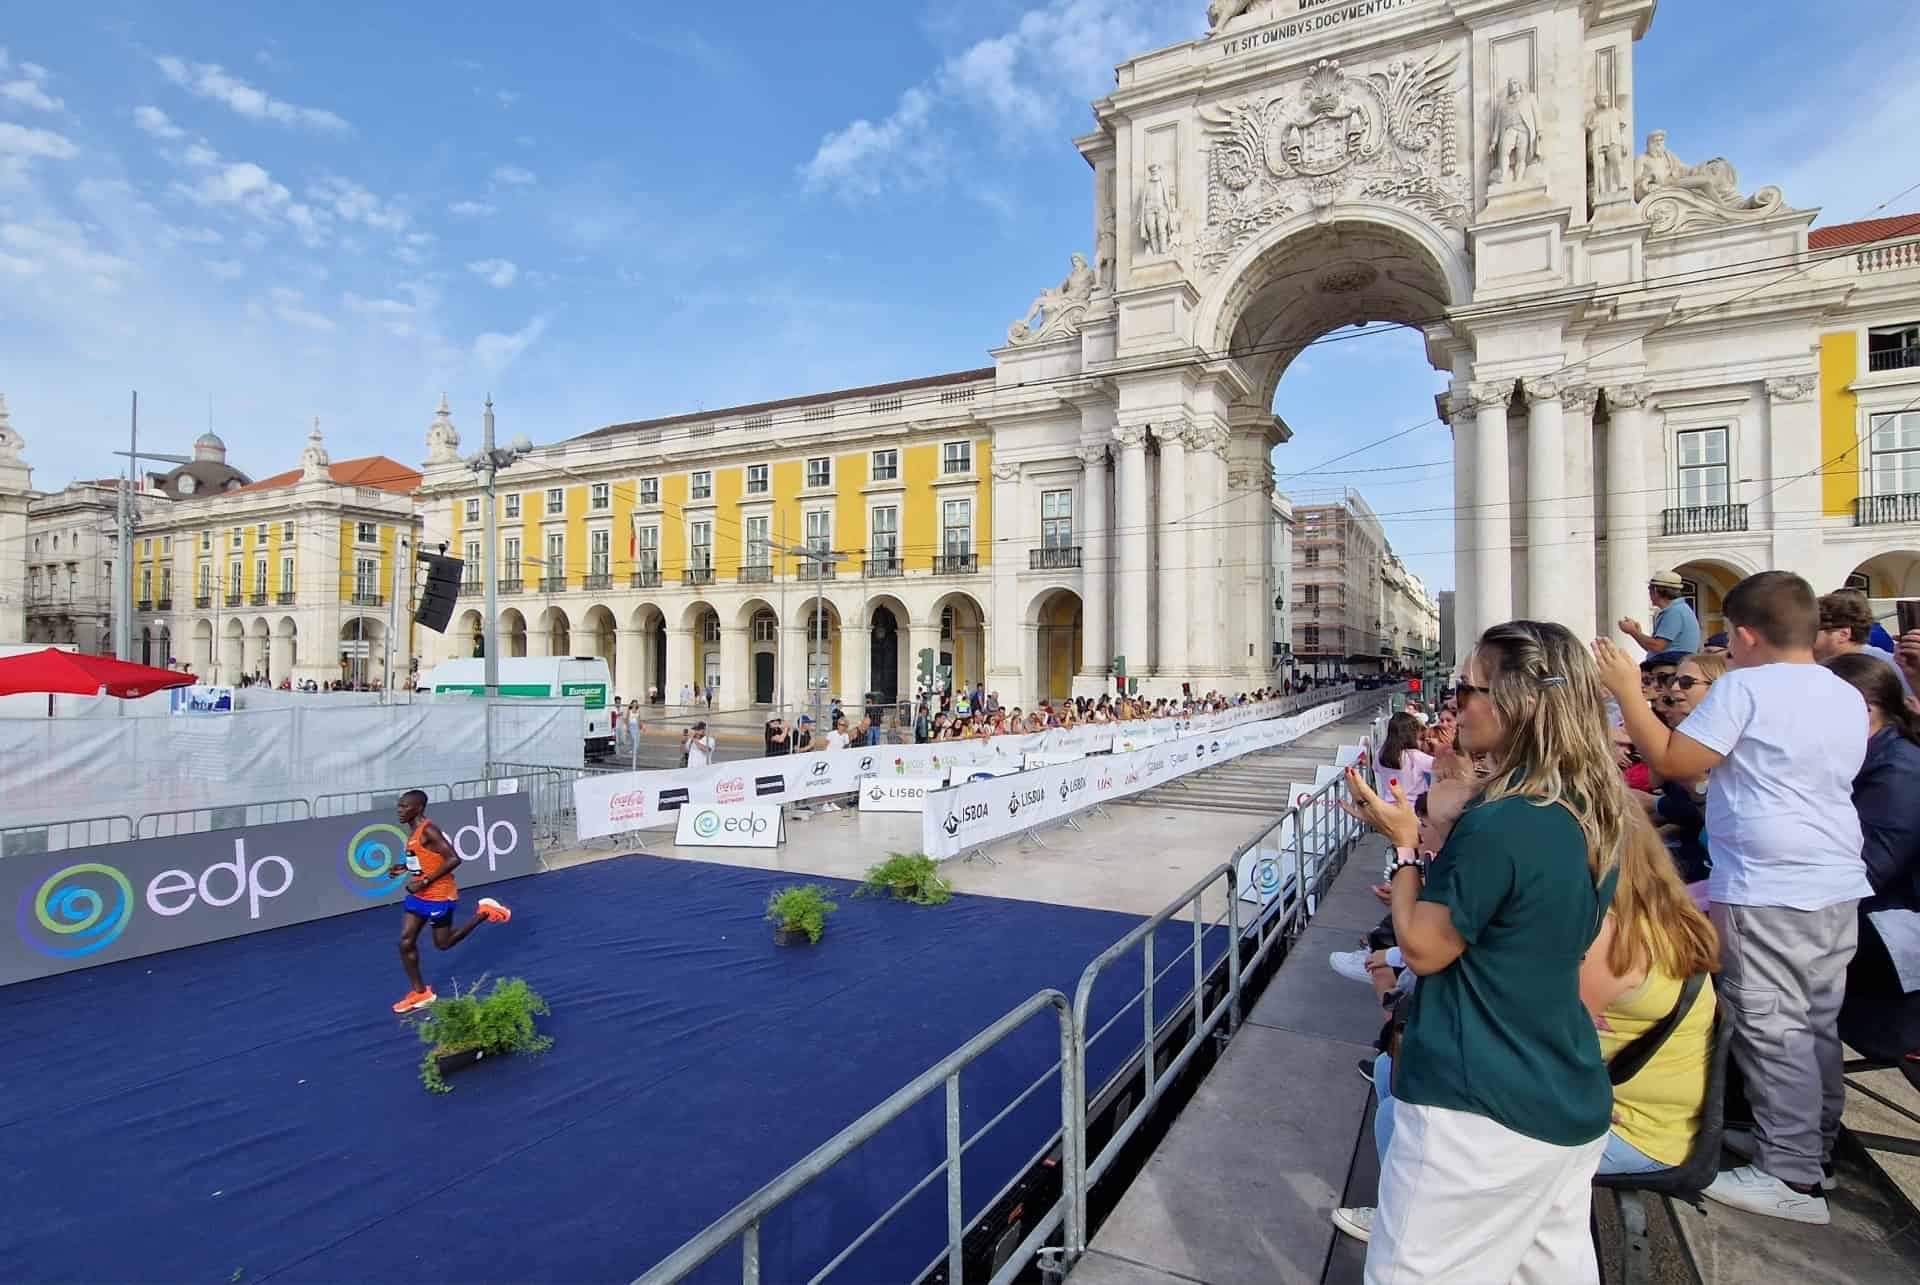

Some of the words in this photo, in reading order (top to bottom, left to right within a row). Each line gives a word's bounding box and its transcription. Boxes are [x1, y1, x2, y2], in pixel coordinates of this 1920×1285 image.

[889, 787, 924, 799] LISBO
[442, 806, 518, 872] dp
[724, 811, 768, 839] edp
[146, 838, 294, 920] edp
